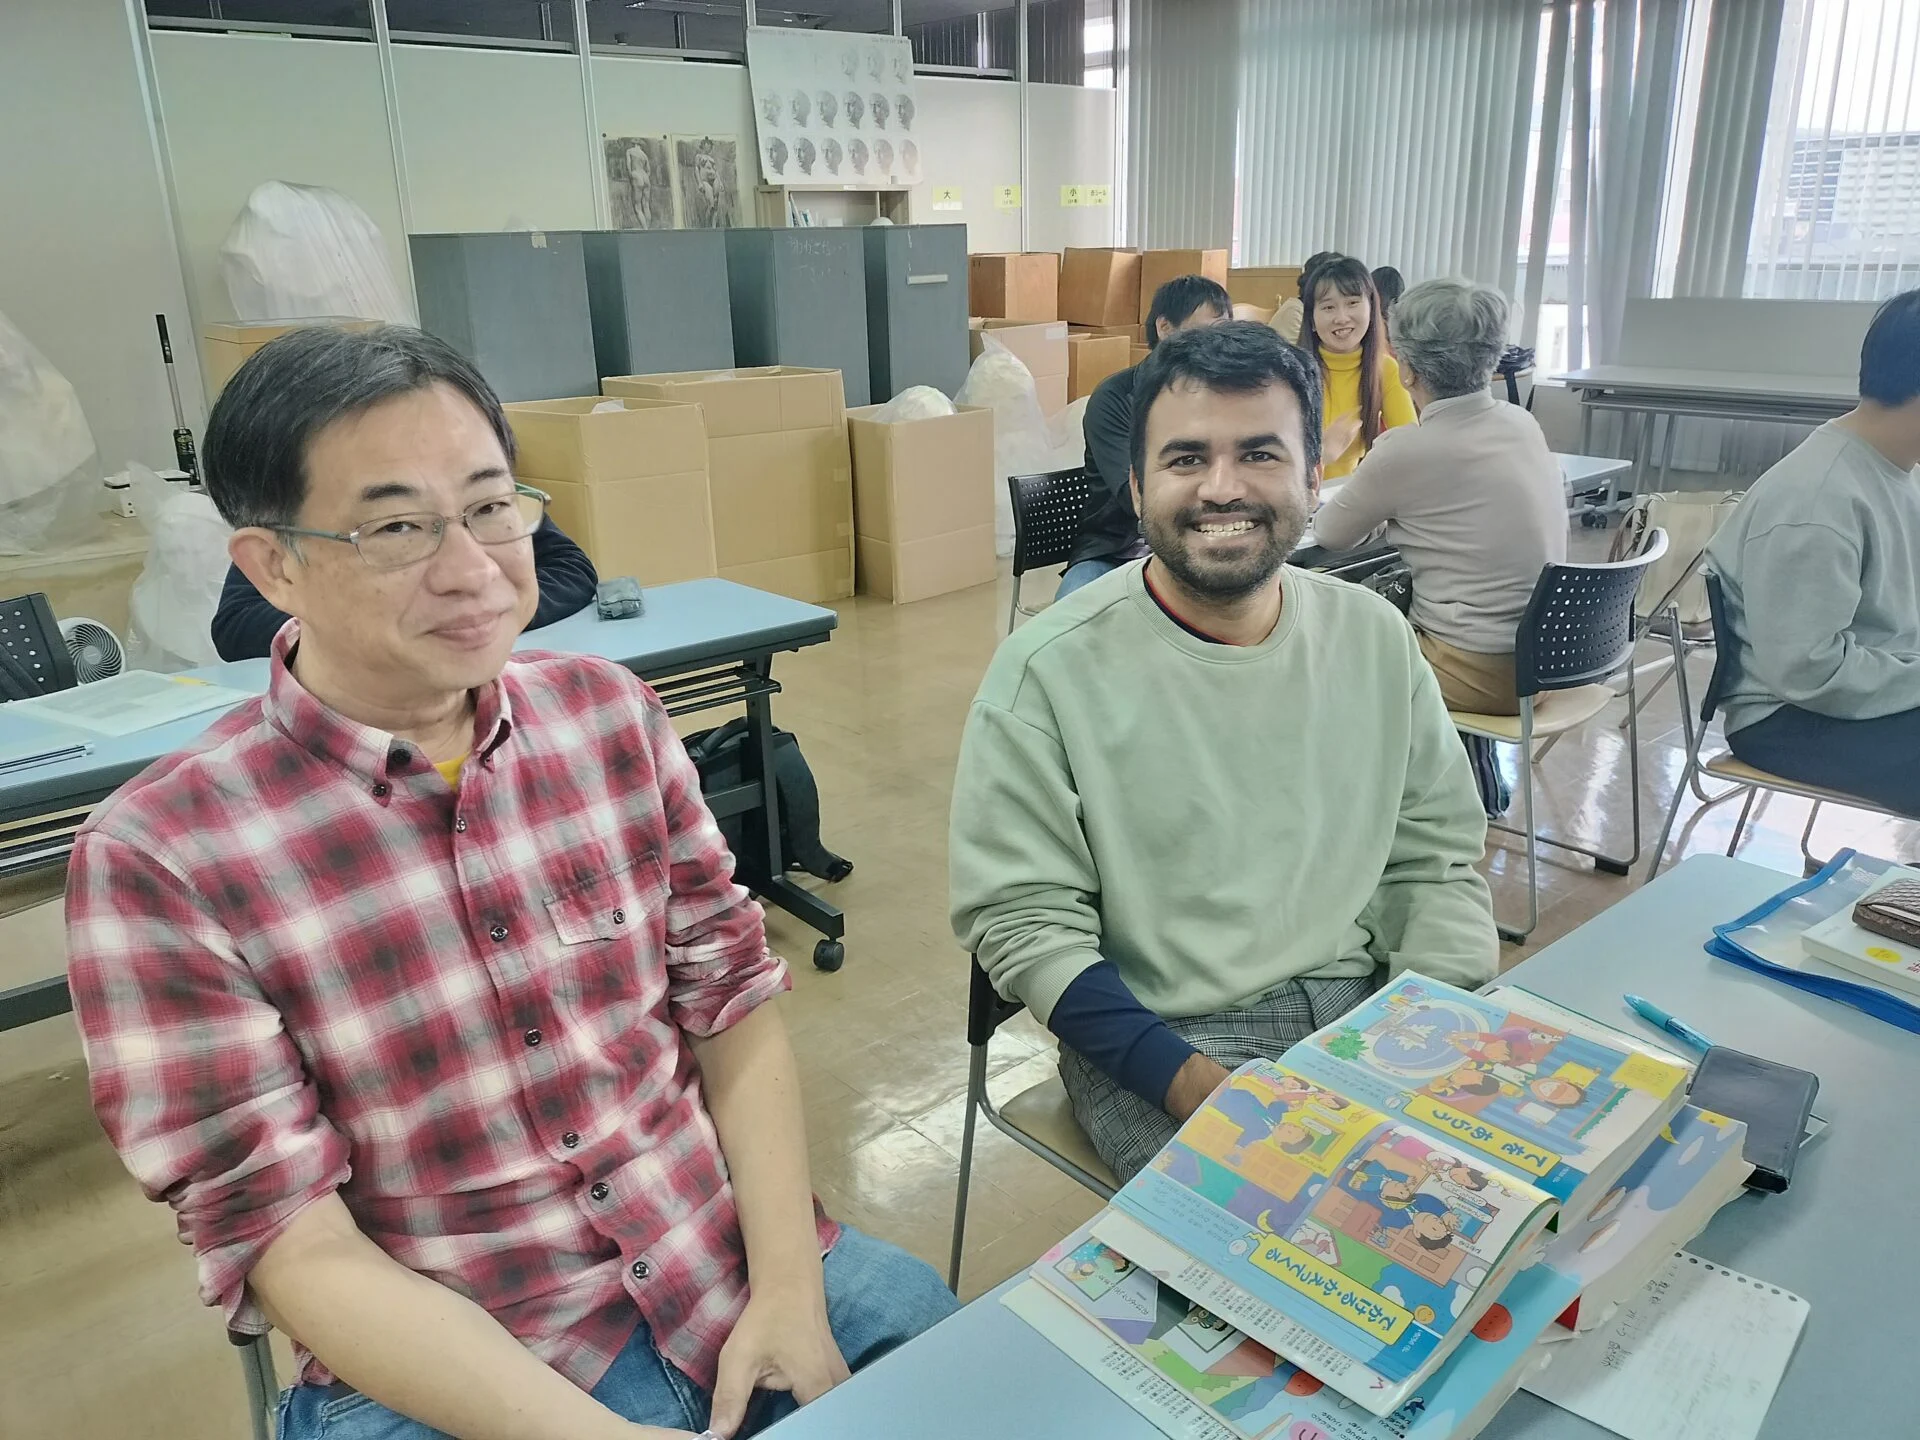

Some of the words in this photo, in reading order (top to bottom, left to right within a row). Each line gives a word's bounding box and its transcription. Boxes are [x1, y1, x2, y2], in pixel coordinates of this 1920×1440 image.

[943, 190, 952, 200] 大
[1004, 188, 1012, 198] 中
[1069, 188, 1077, 197] 小
[1432, 1109, 1494, 1141] あらう
[1501, 1142, 1548, 1168] てを
[1265, 1247, 1398, 1331] でかける・かえってくる
